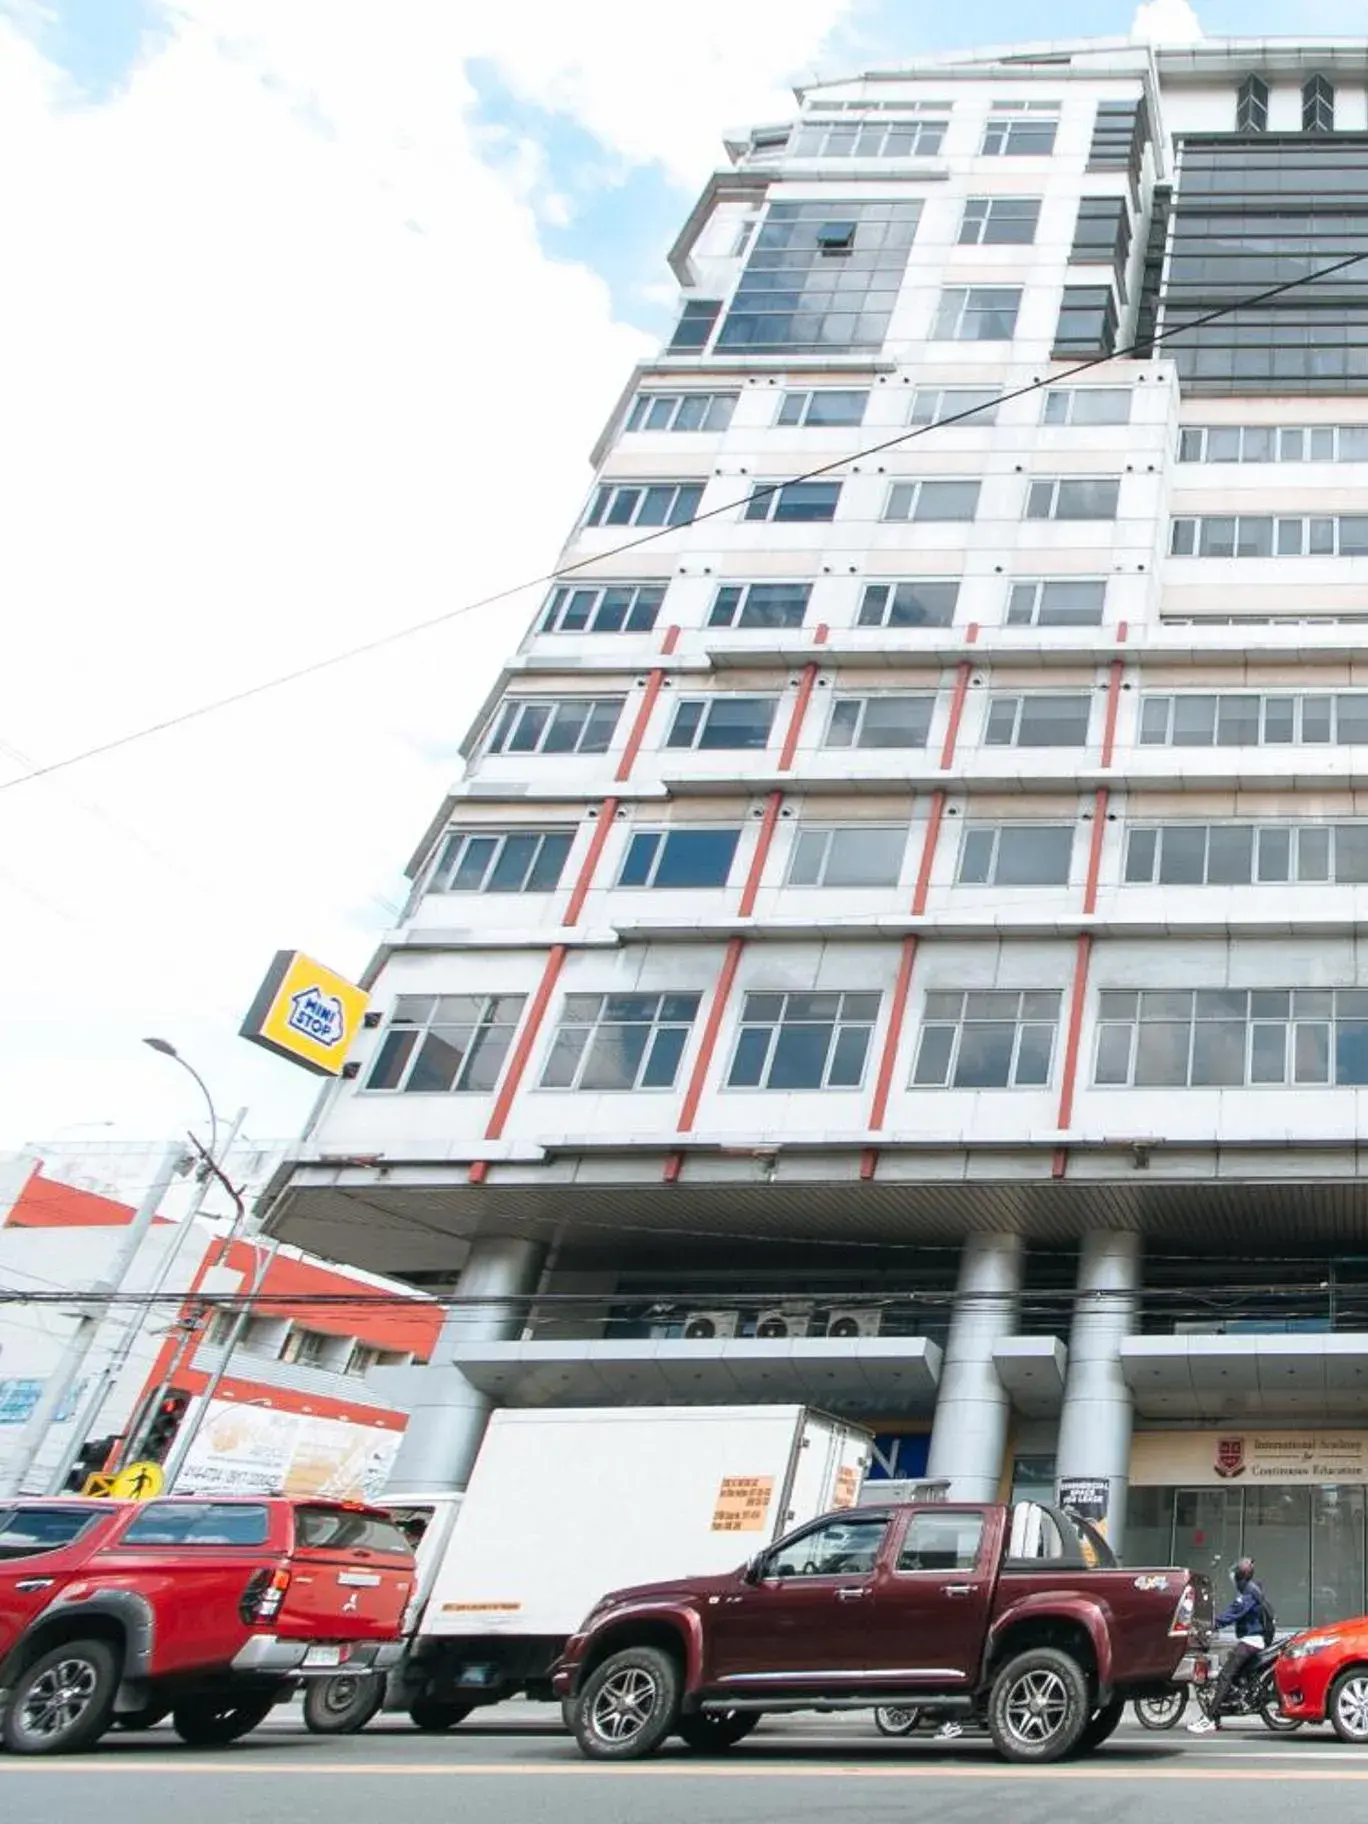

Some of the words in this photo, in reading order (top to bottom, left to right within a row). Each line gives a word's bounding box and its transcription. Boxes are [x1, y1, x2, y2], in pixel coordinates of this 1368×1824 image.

[304, 998, 336, 1022] MINI
[296, 1011, 331, 1035] STOP
[1254, 1438, 1315, 1450] International
[1321, 1438, 1362, 1453] Academy
[1252, 1465, 1308, 1476] Continuous
[1313, 1465, 1363, 1476] Education
